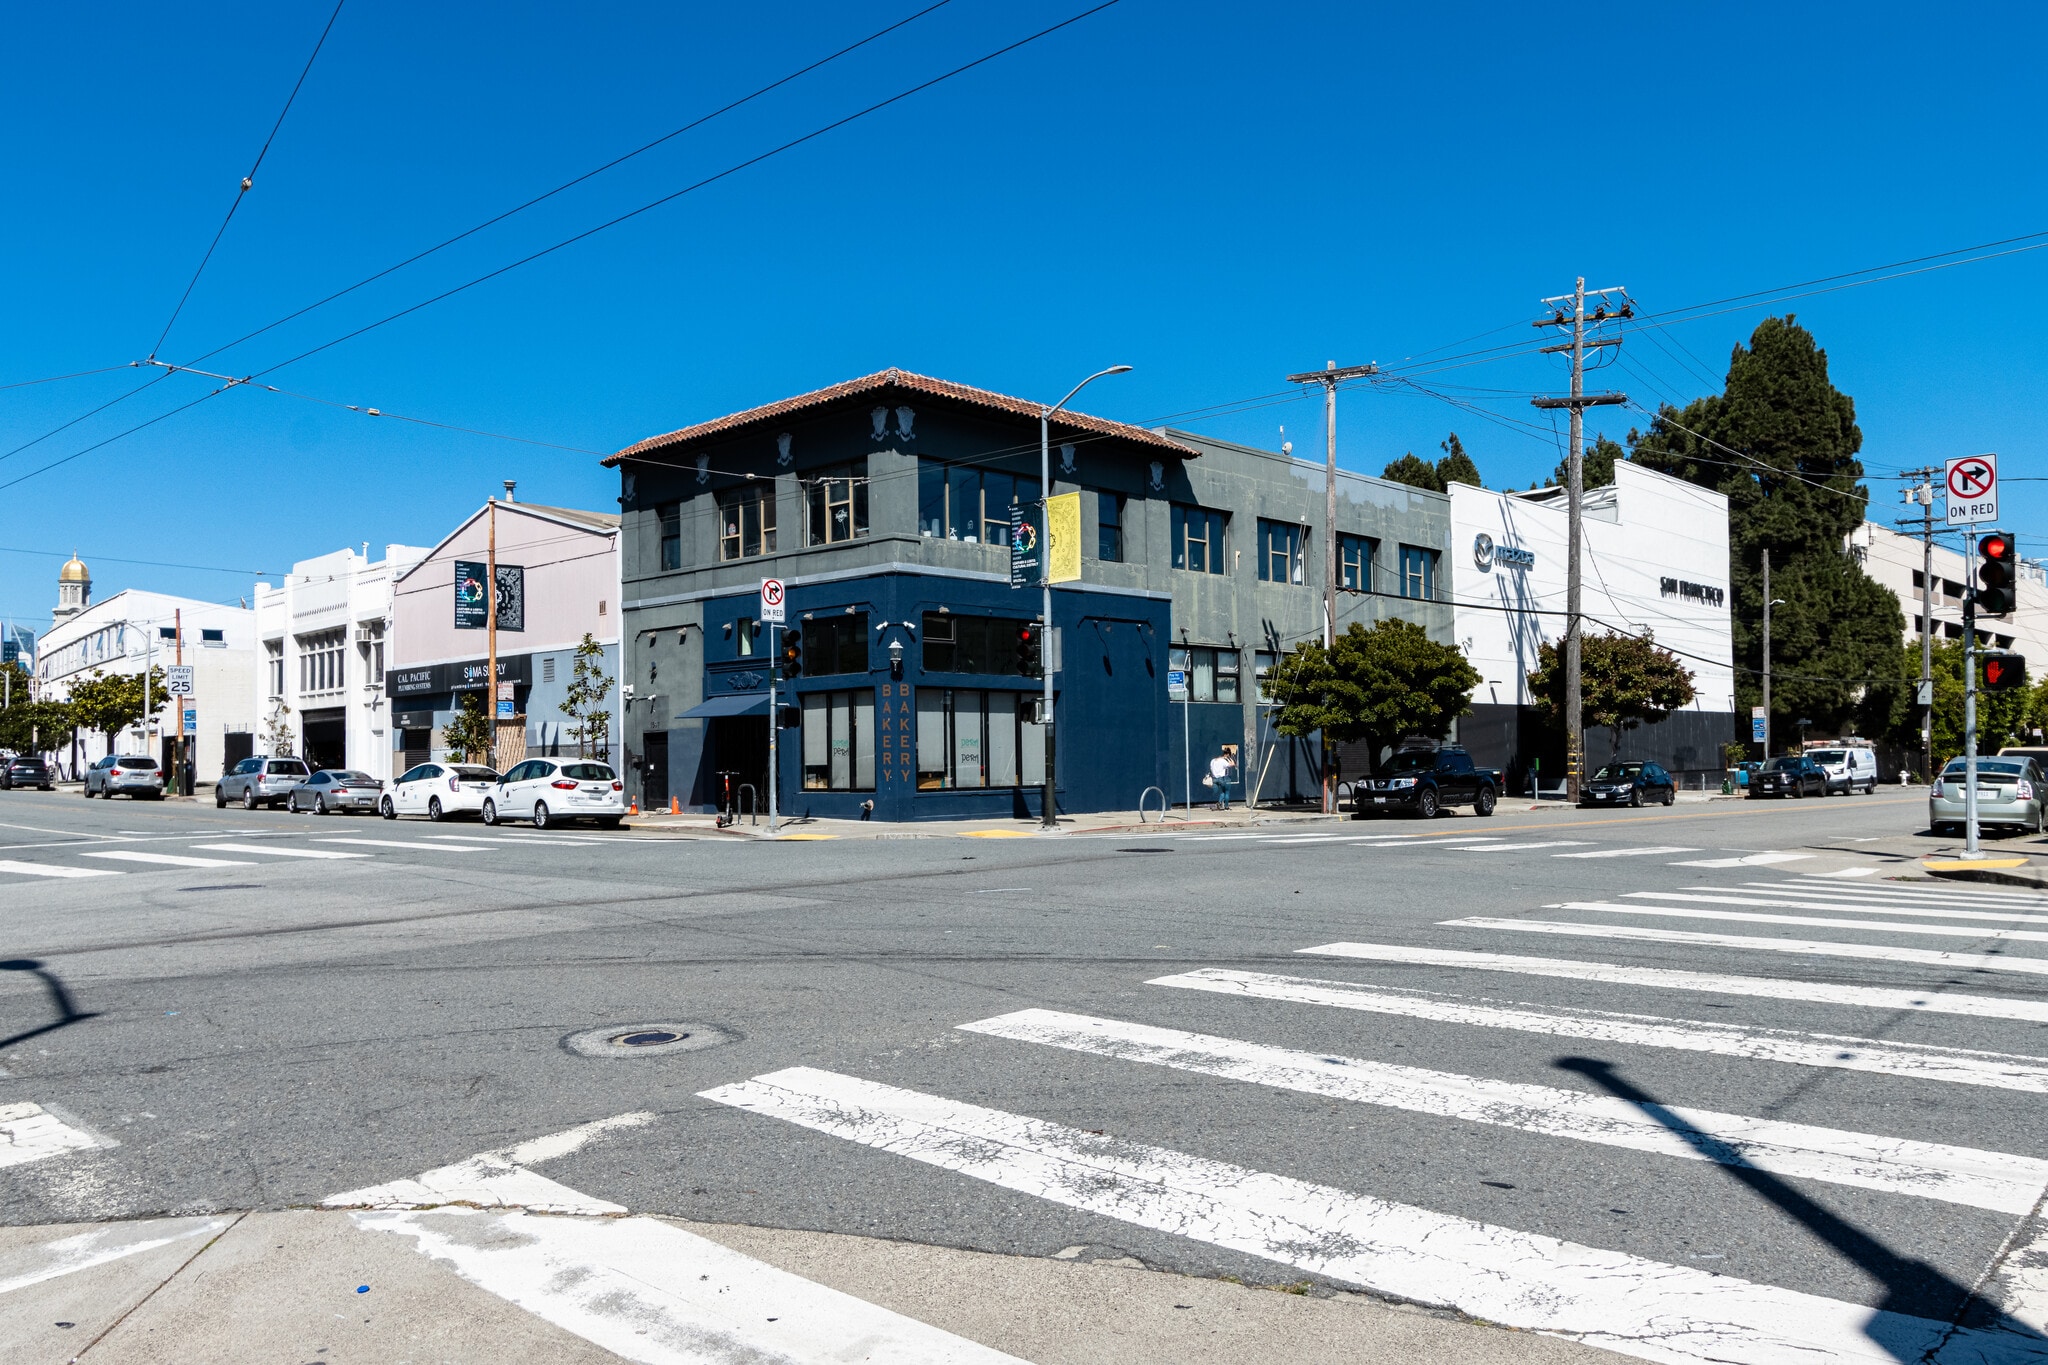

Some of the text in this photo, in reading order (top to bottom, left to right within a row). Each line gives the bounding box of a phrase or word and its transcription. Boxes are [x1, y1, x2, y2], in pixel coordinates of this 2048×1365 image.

[1951, 503, 1994, 517] ON RED
[1660, 577, 1724, 602] SAN FRANCISCO
[763, 608, 784, 617] ON RED
[398, 671, 431, 684] CAL PACIFIC
[171, 681, 191, 692] 25
[882, 684, 892, 782] BAKERY
[900, 684, 910, 782] BAKERY
